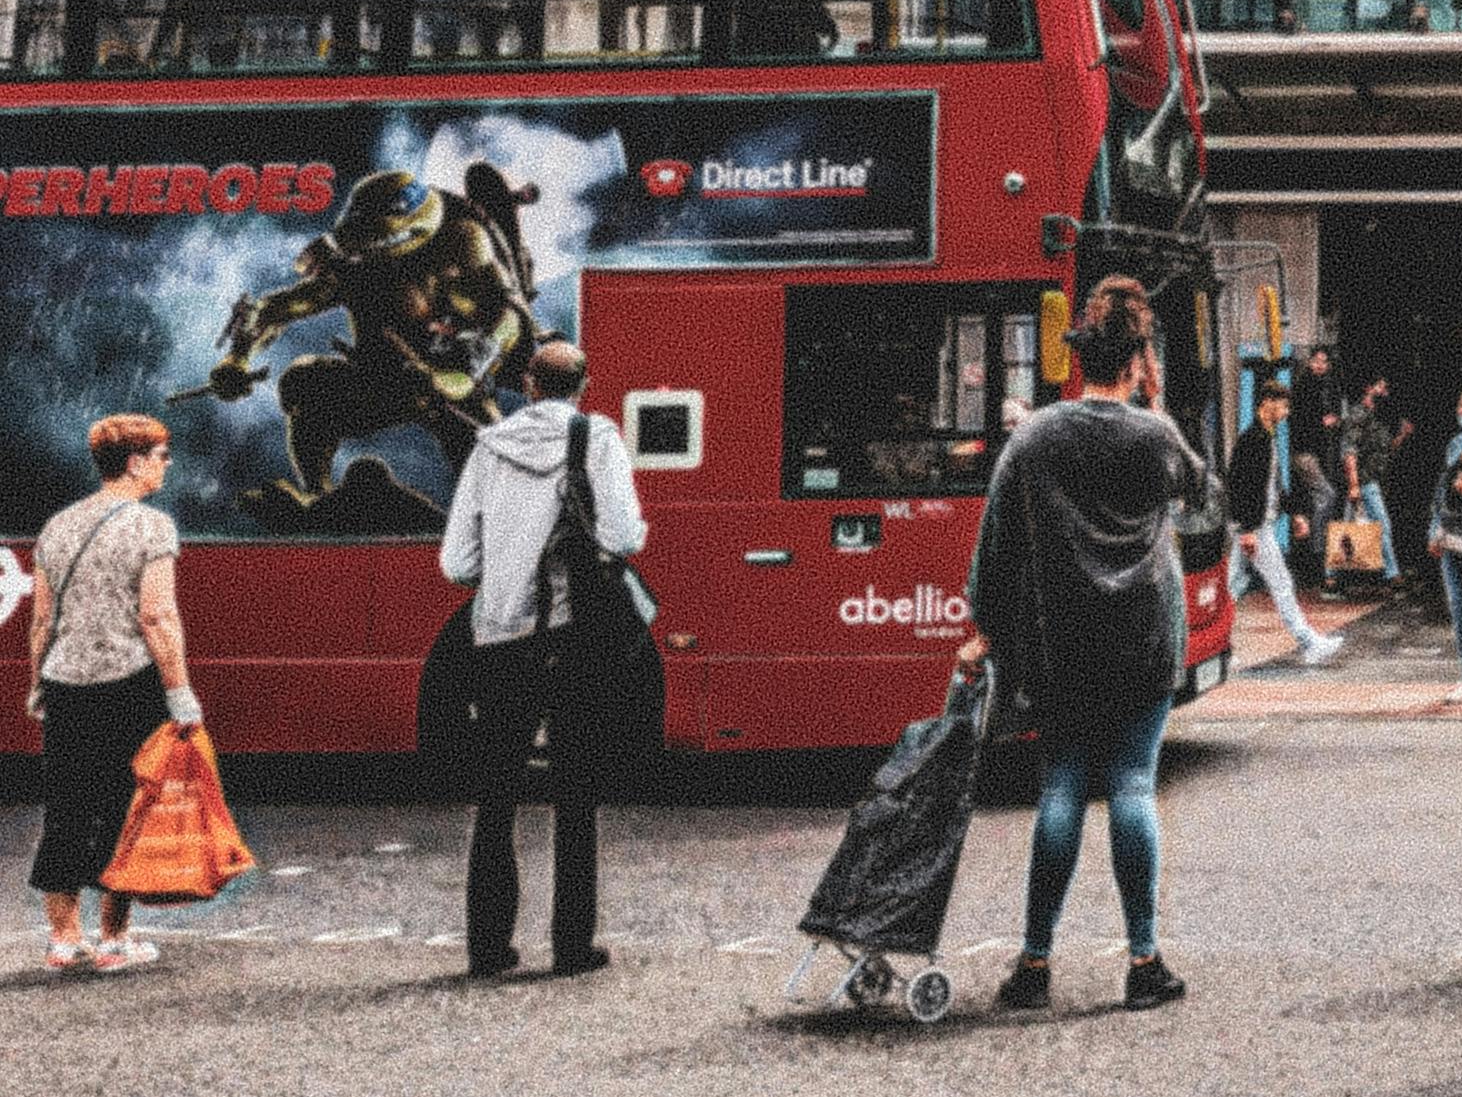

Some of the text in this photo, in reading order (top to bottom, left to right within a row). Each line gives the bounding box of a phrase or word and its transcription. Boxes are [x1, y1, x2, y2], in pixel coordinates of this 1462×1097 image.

[0, 161, 336, 217] ERHEROES
[702, 159, 796, 188] Direct
[838, 583, 969, 625] abellio
